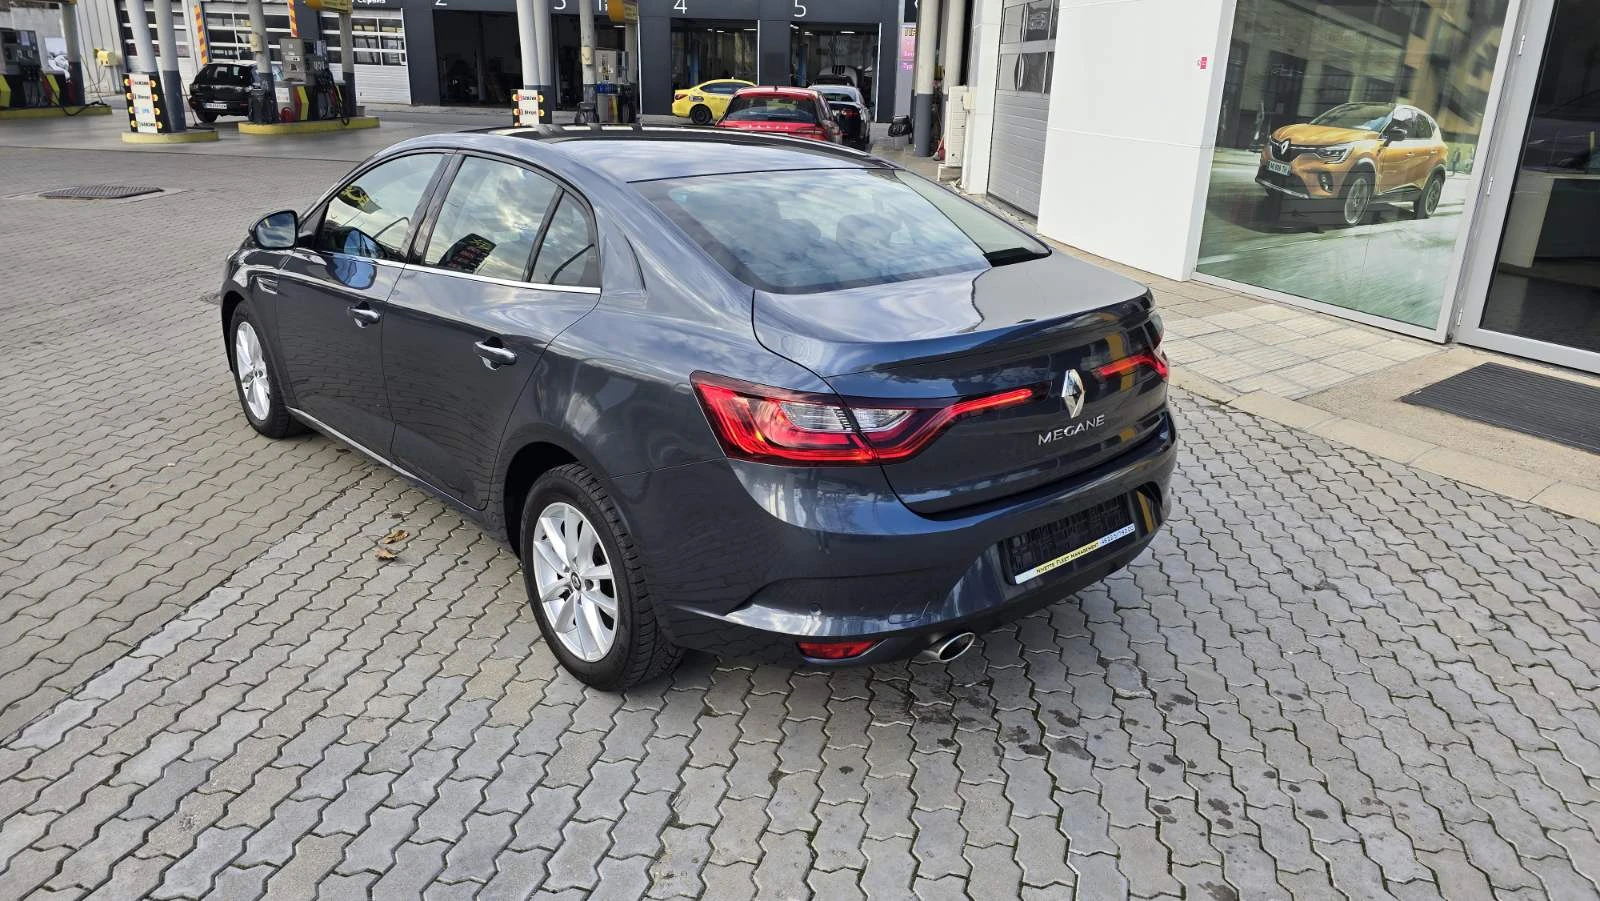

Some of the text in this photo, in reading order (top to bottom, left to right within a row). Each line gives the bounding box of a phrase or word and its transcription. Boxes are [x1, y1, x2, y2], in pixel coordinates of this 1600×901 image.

[673, 0, 688, 14] 4
[793, 0, 807, 18] 5
[1038, 414, 1105, 446] MEGANE
